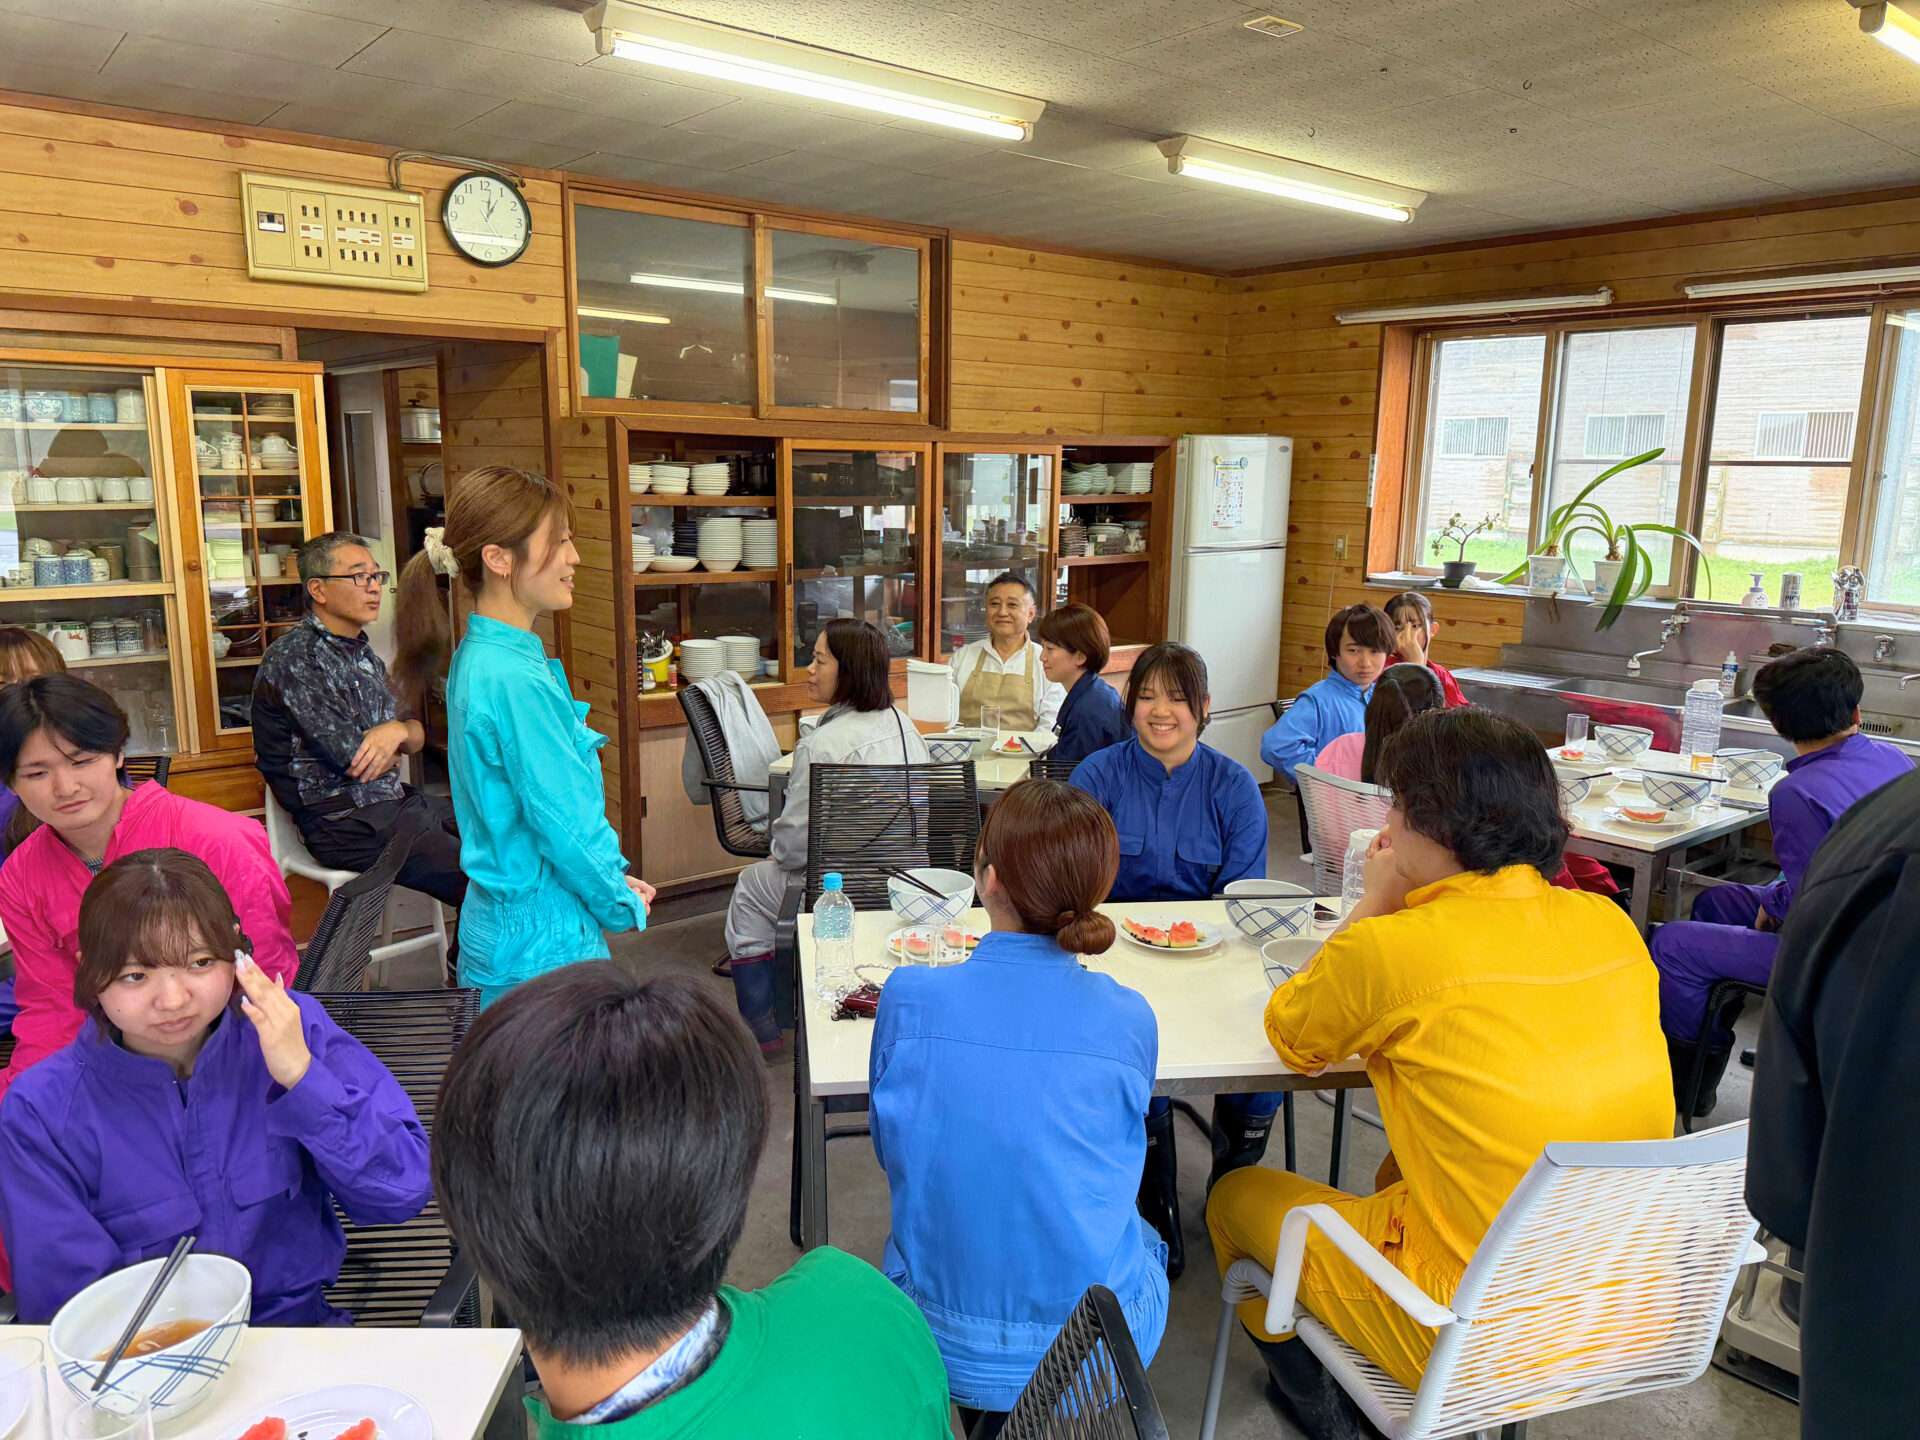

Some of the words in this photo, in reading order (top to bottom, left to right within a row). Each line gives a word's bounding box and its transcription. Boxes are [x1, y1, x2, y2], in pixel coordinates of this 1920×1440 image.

[464, 183, 473, 194] 11
[479, 180, 491, 191] 12
[499, 187, 504, 198] 1
[454, 195, 465, 205] 10
[510, 200, 517, 211] 2
[450, 211, 458, 221] 9
[514, 218, 523, 228] 3
[484, 249, 492, 259] 6
